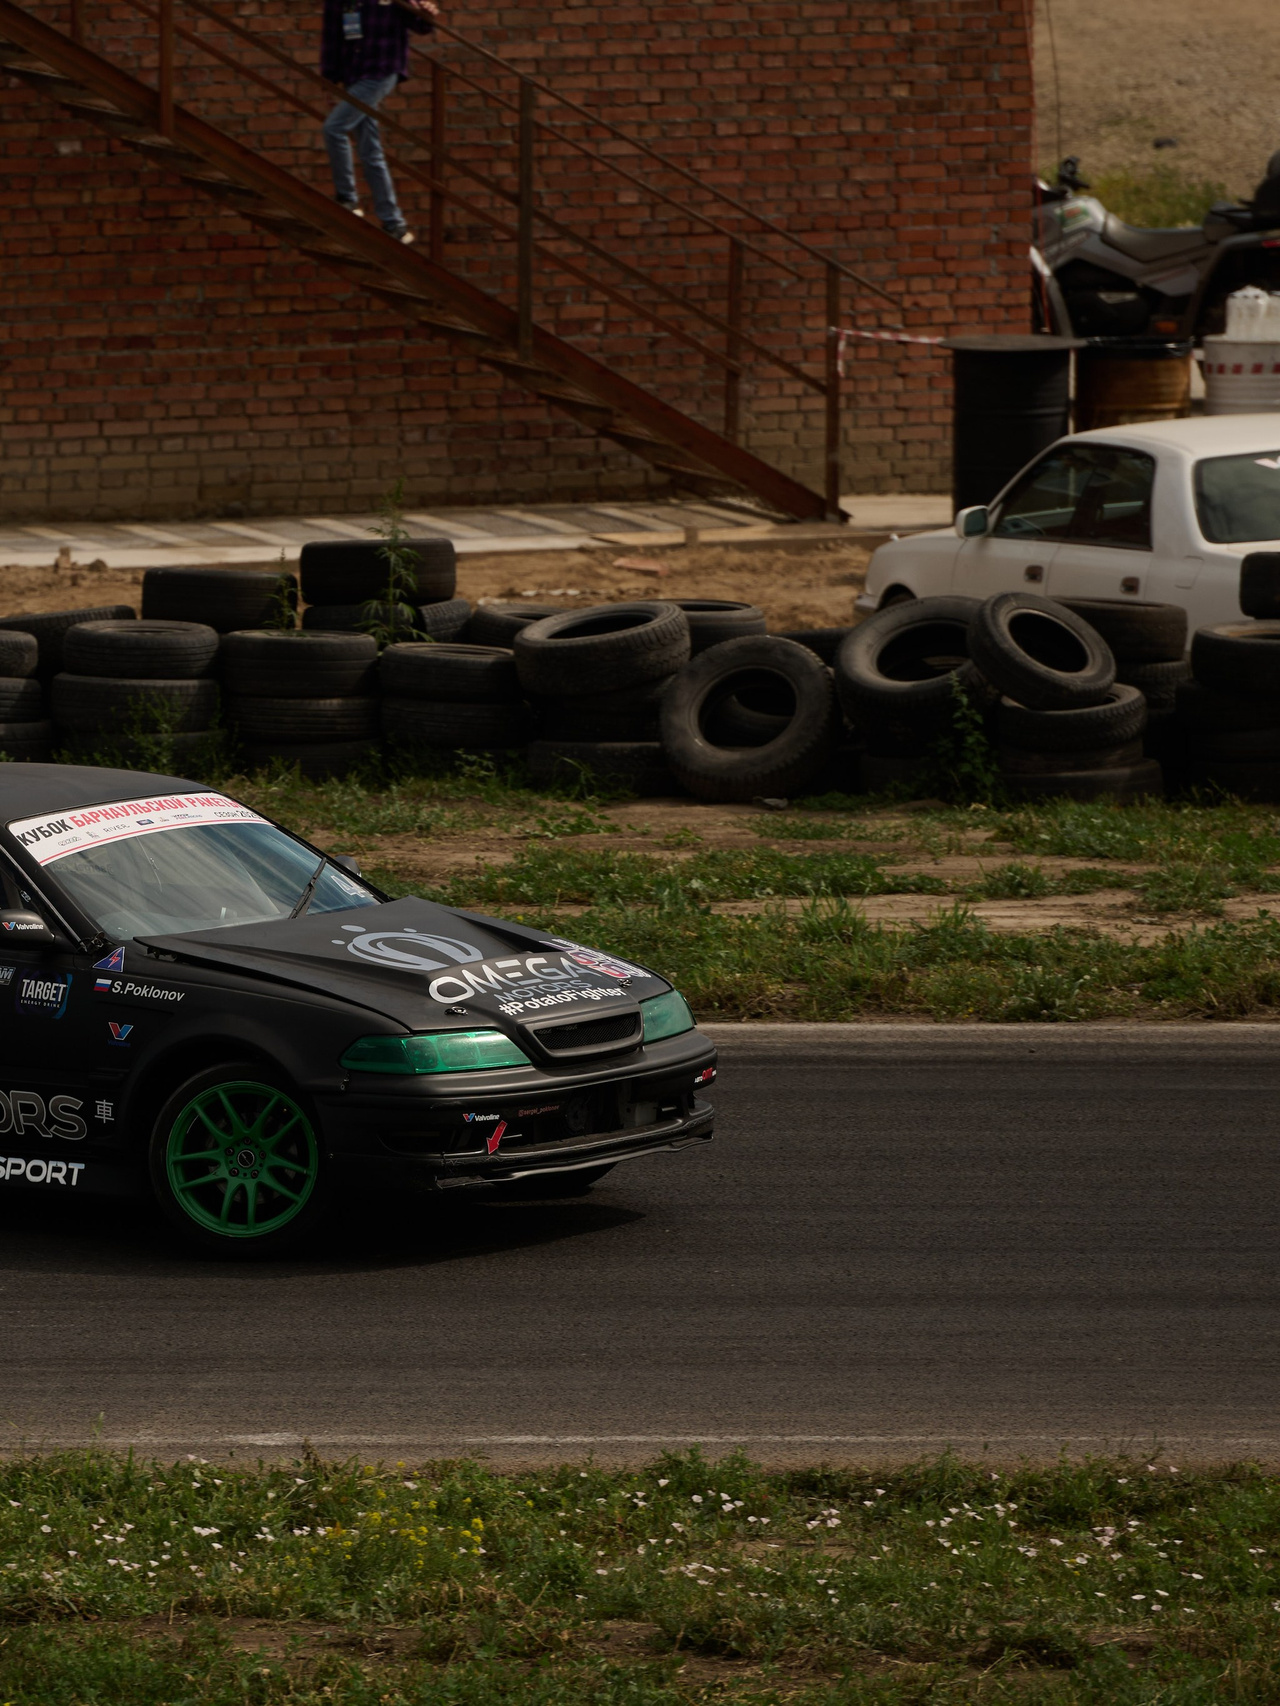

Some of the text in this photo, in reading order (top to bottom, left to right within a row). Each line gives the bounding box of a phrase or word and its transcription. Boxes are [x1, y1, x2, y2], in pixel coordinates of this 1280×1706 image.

[17, 797, 244, 847] КУБОК БАРНАУЛЬСКОЙ РАКЕТЫ
[22, 979, 68, 1002] TARGET
[111, 981, 185, 1002] S.Poklonov
[428, 957, 603, 1004] OMEGA
[494, 979, 593, 1004] MOTORS
[498, 987, 627, 1016] #PotatoFighter
[94, 1099, 116, 1124] 車
